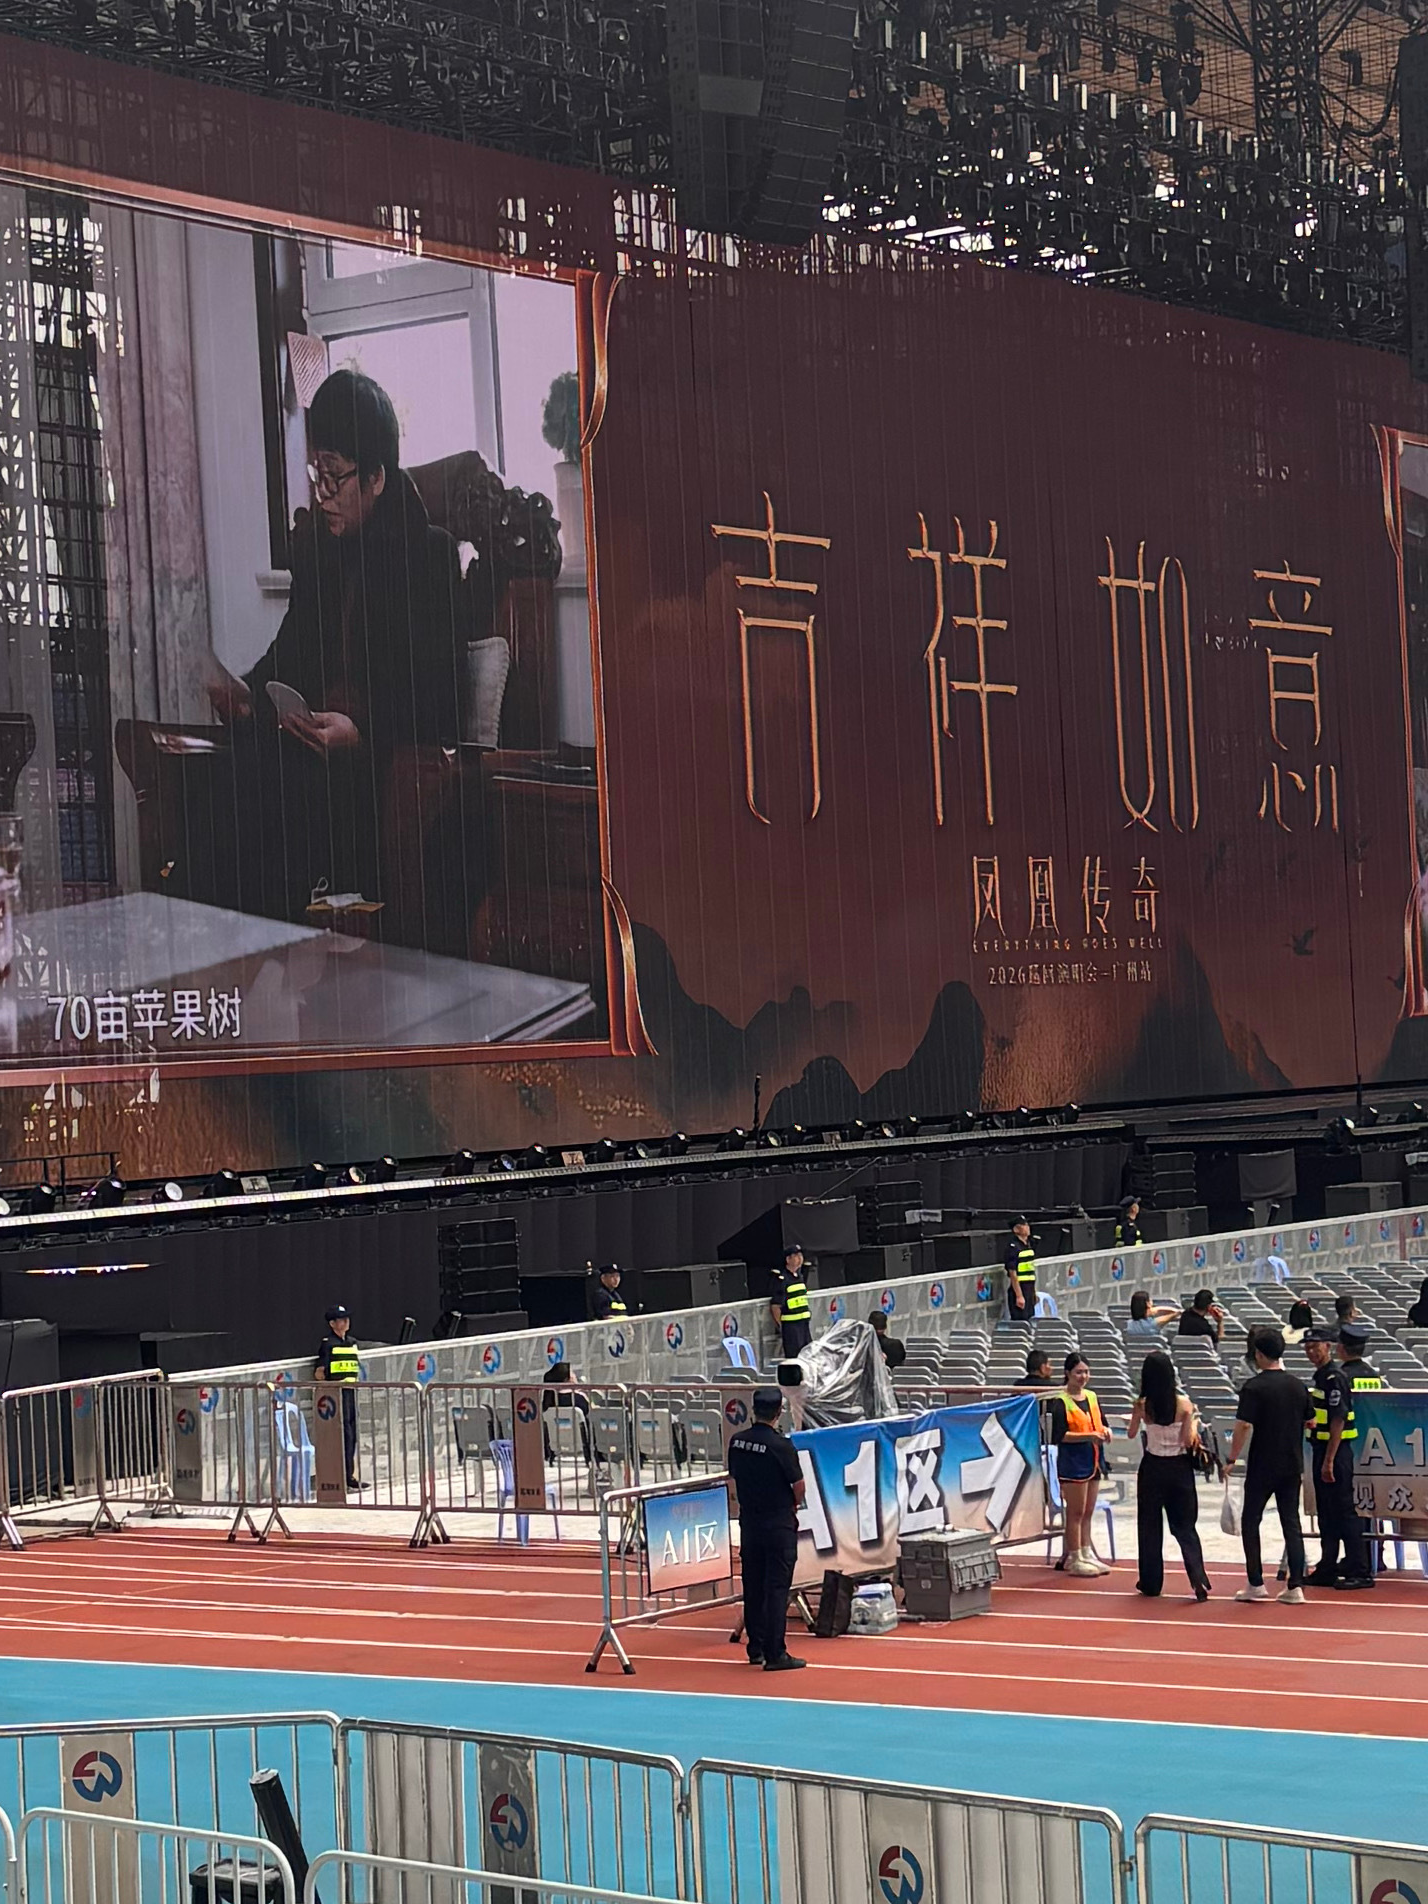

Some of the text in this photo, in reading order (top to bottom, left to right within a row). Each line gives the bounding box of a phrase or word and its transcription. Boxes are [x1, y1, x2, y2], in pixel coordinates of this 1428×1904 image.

[710, 490, 1340, 833] 吉祥如意
[973, 855, 1160, 936] 凤凰传奇
[47, 986, 242, 1042] 70亩苹果树
